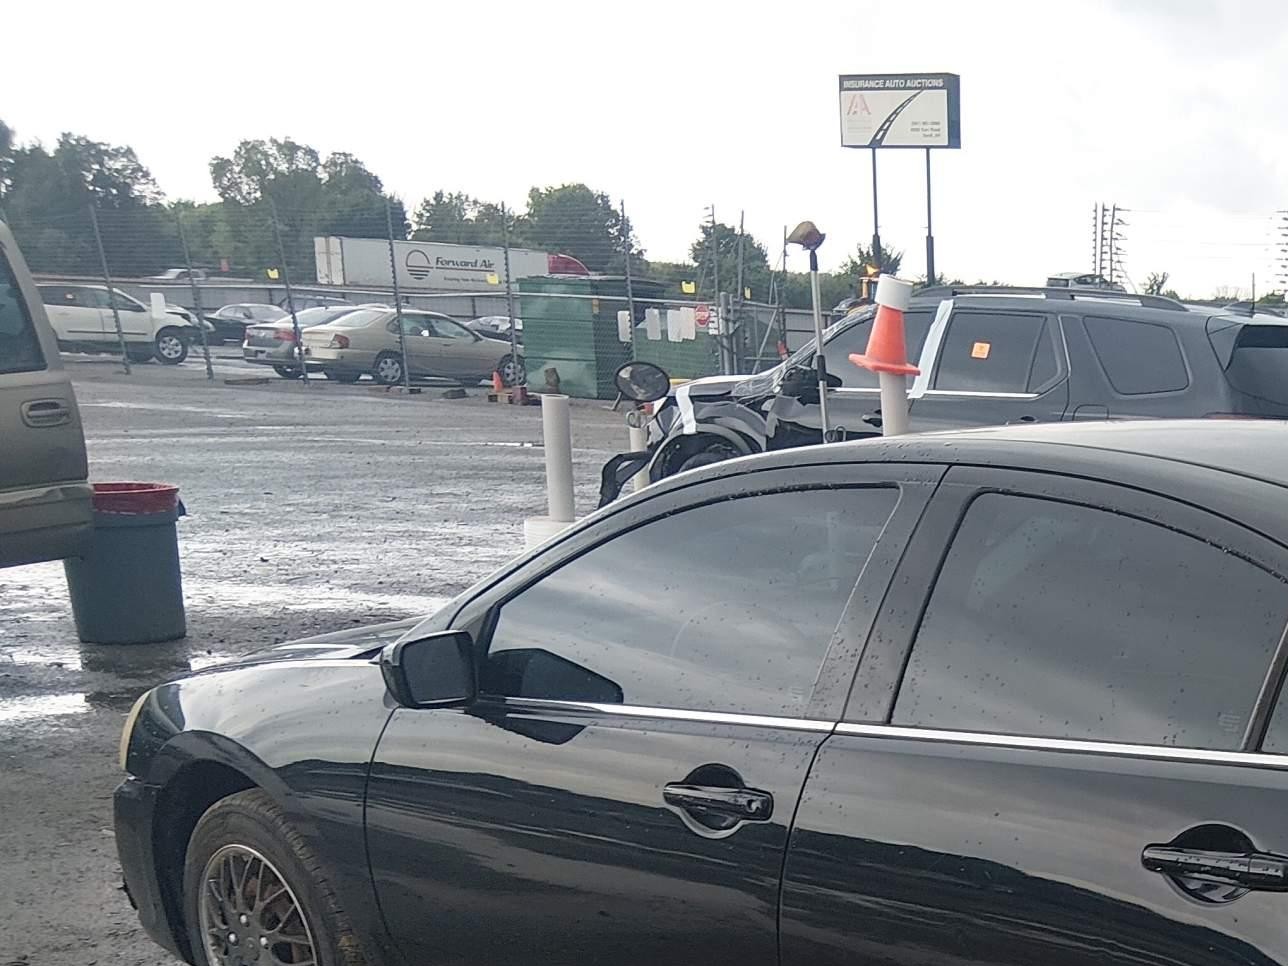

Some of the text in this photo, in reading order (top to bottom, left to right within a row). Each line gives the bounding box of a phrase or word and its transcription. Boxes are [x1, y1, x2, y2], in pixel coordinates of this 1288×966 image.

[843, 78, 944, 89] INSURANCE AUTO AUCTIONS
[435, 256, 495, 269] Forward Air
